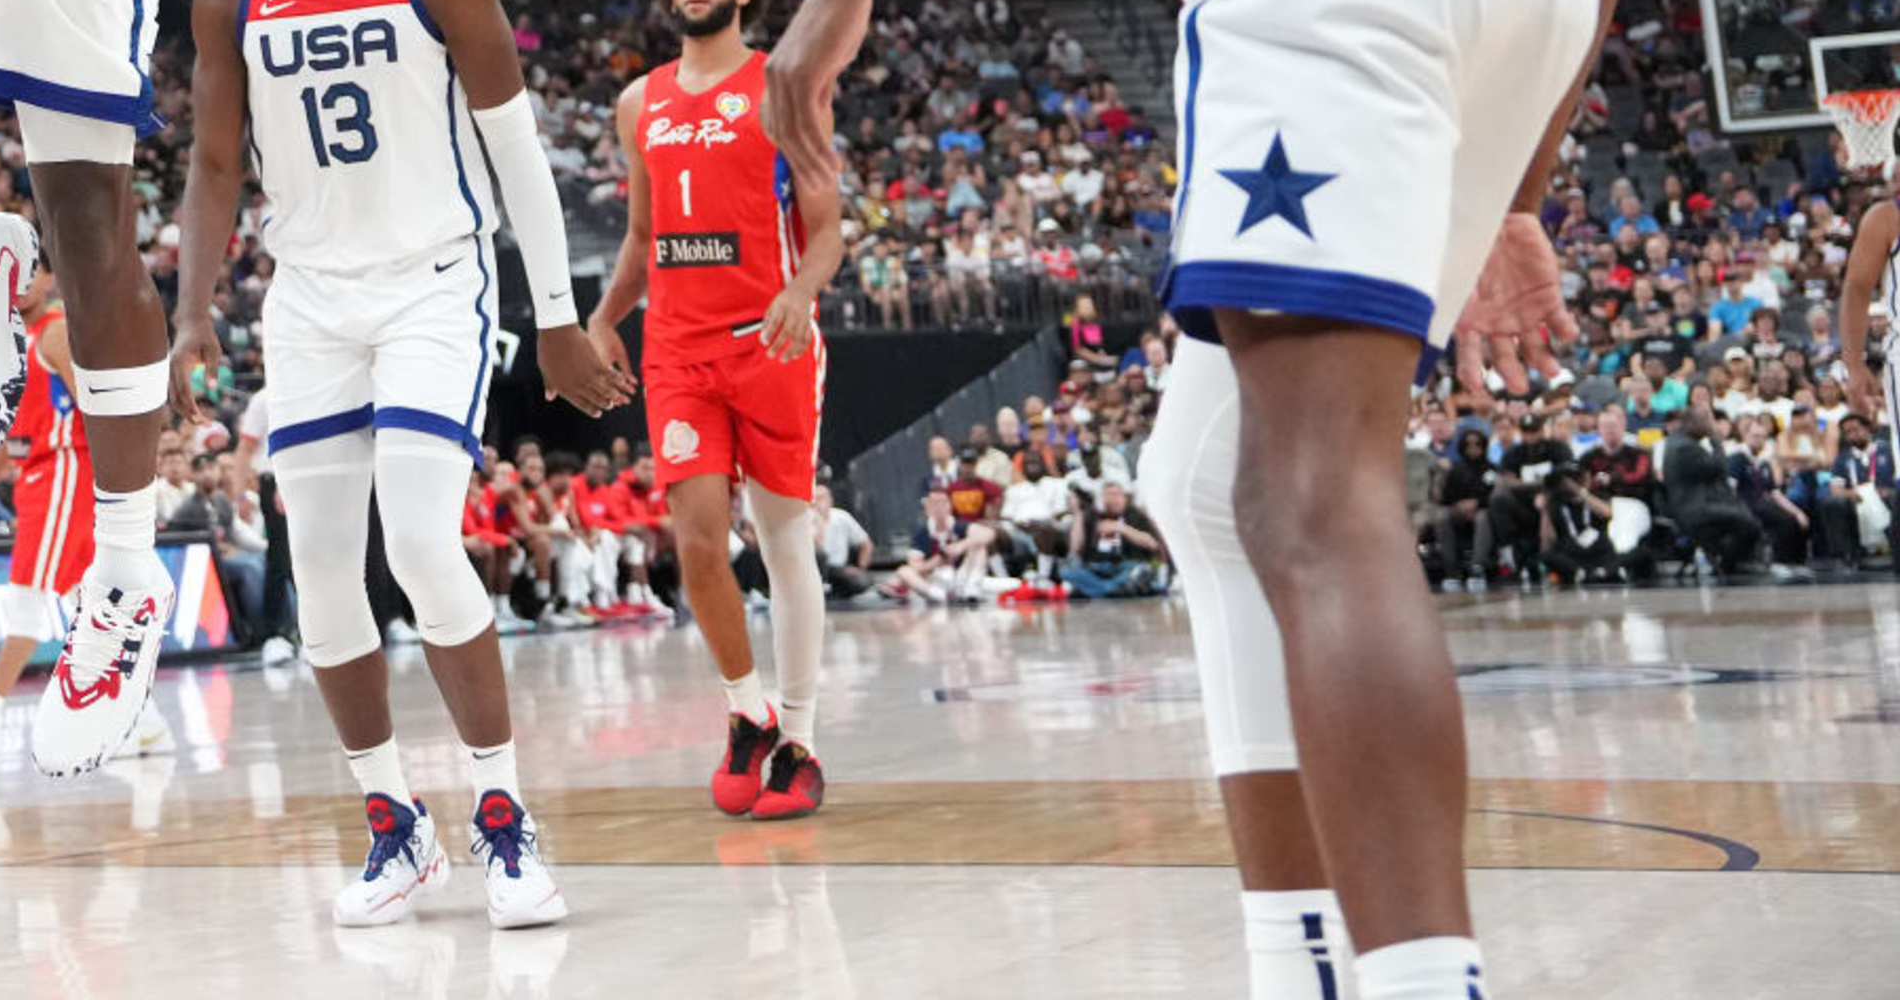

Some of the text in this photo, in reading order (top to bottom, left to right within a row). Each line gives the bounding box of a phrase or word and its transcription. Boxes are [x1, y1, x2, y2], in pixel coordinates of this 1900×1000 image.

[259, 19, 398, 78] USA
[300, 81, 379, 168] 13
[677, 168, 693, 217] 1
